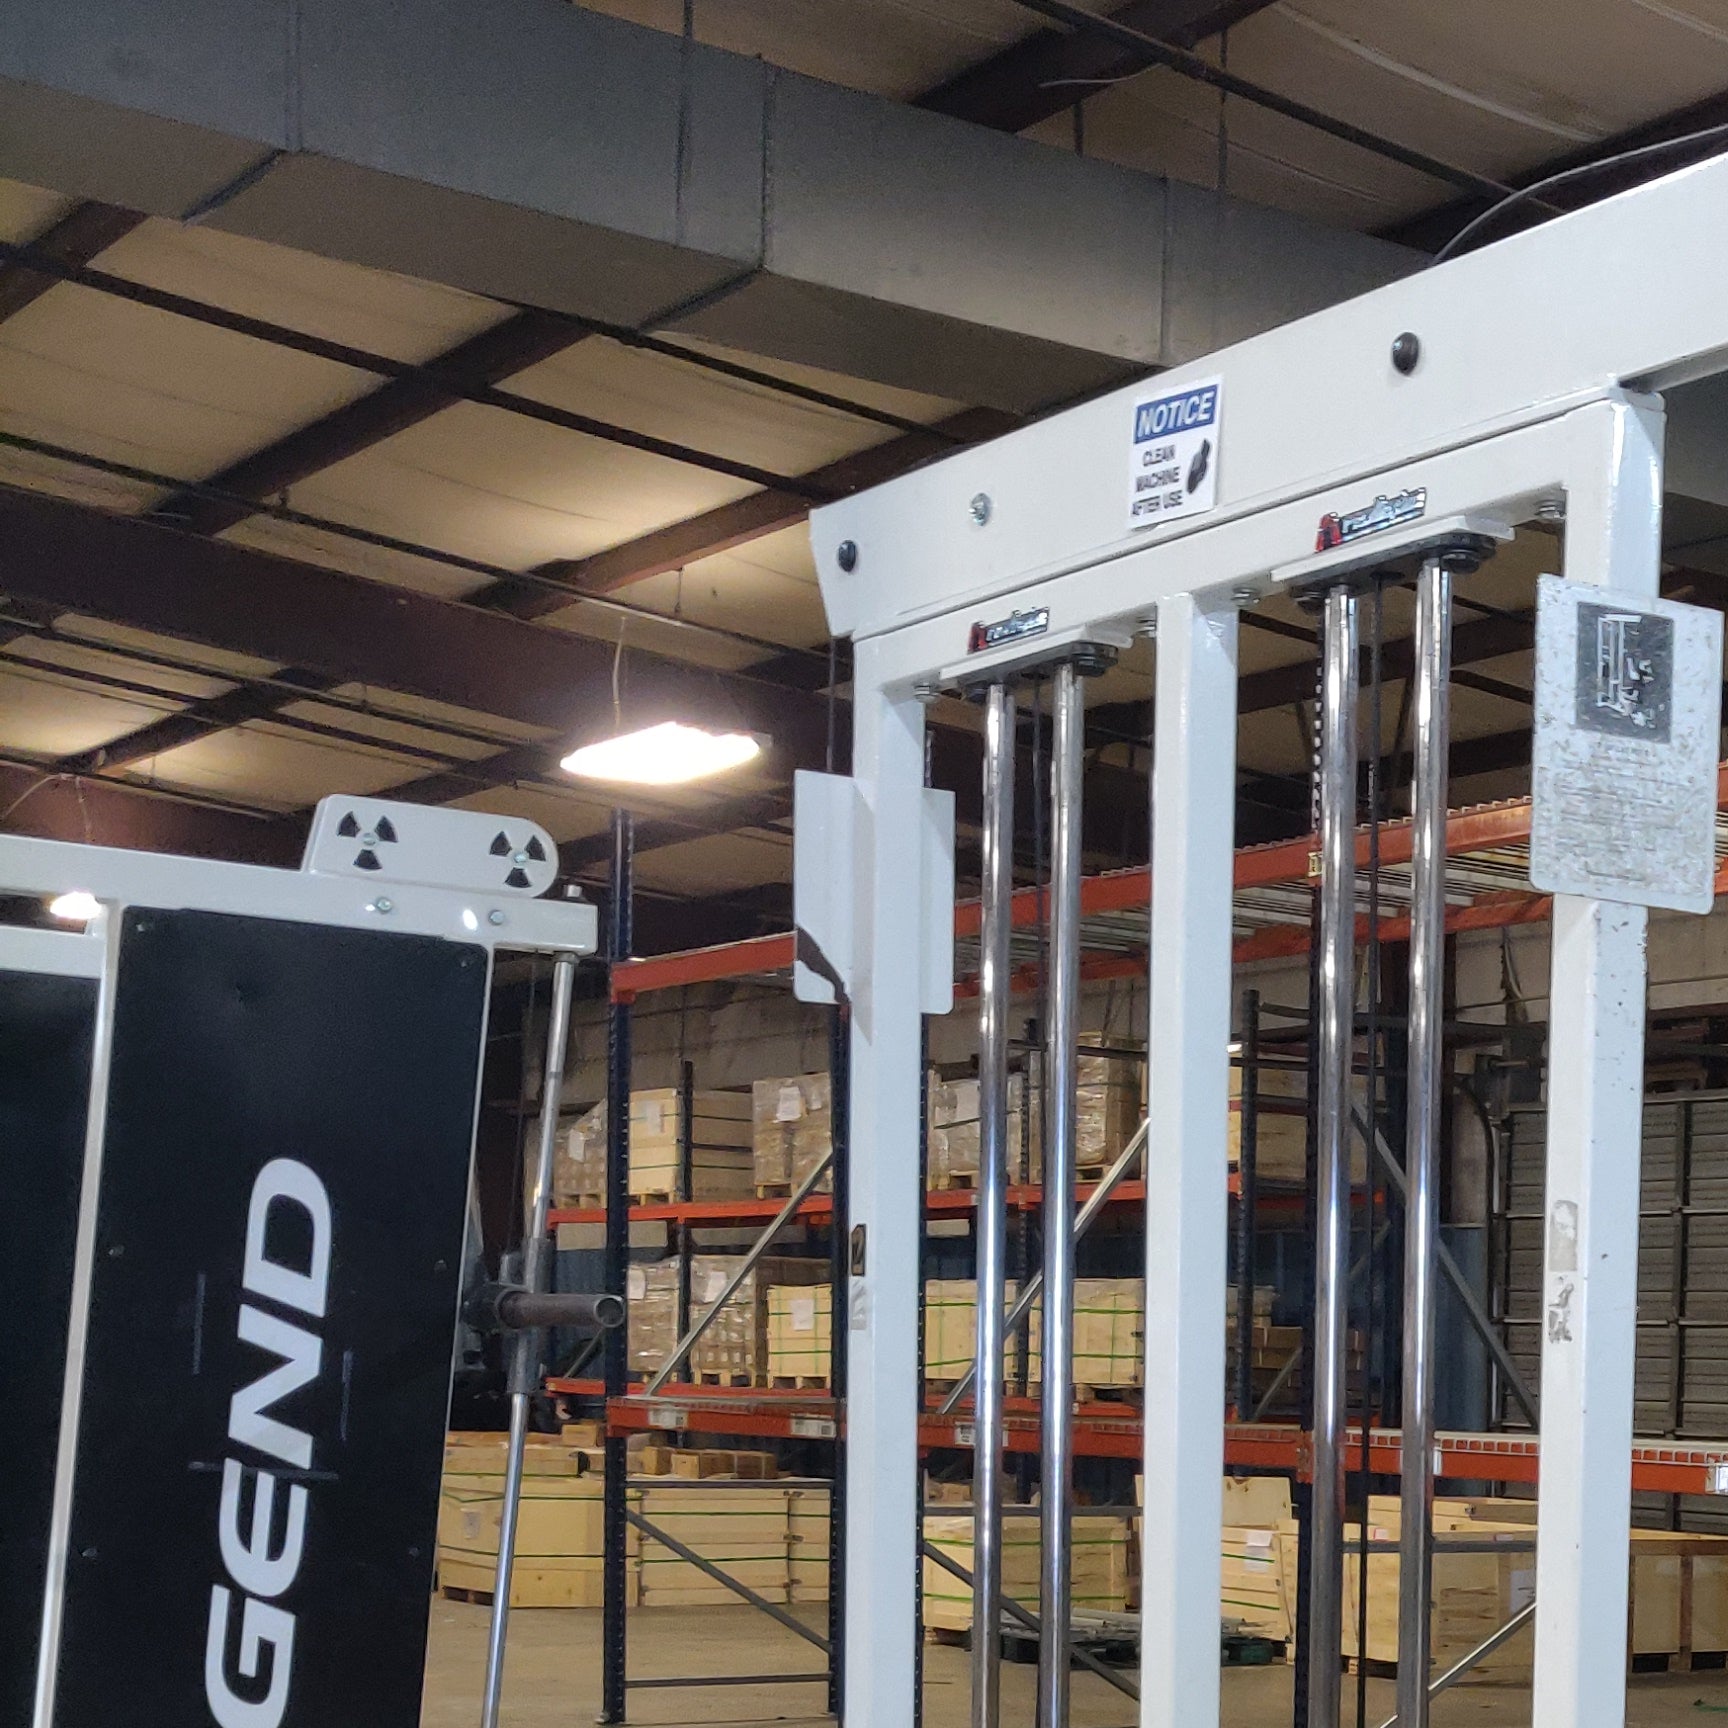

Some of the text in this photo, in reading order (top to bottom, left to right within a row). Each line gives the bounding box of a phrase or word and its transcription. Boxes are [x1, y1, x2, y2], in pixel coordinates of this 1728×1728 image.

[1138, 391, 1214, 437] NOTICE
[1143, 445, 1175, 467] CLEAN
[1136, 467, 1180, 492] MACHINE
[1132, 490, 1182, 515] AFTER USE
